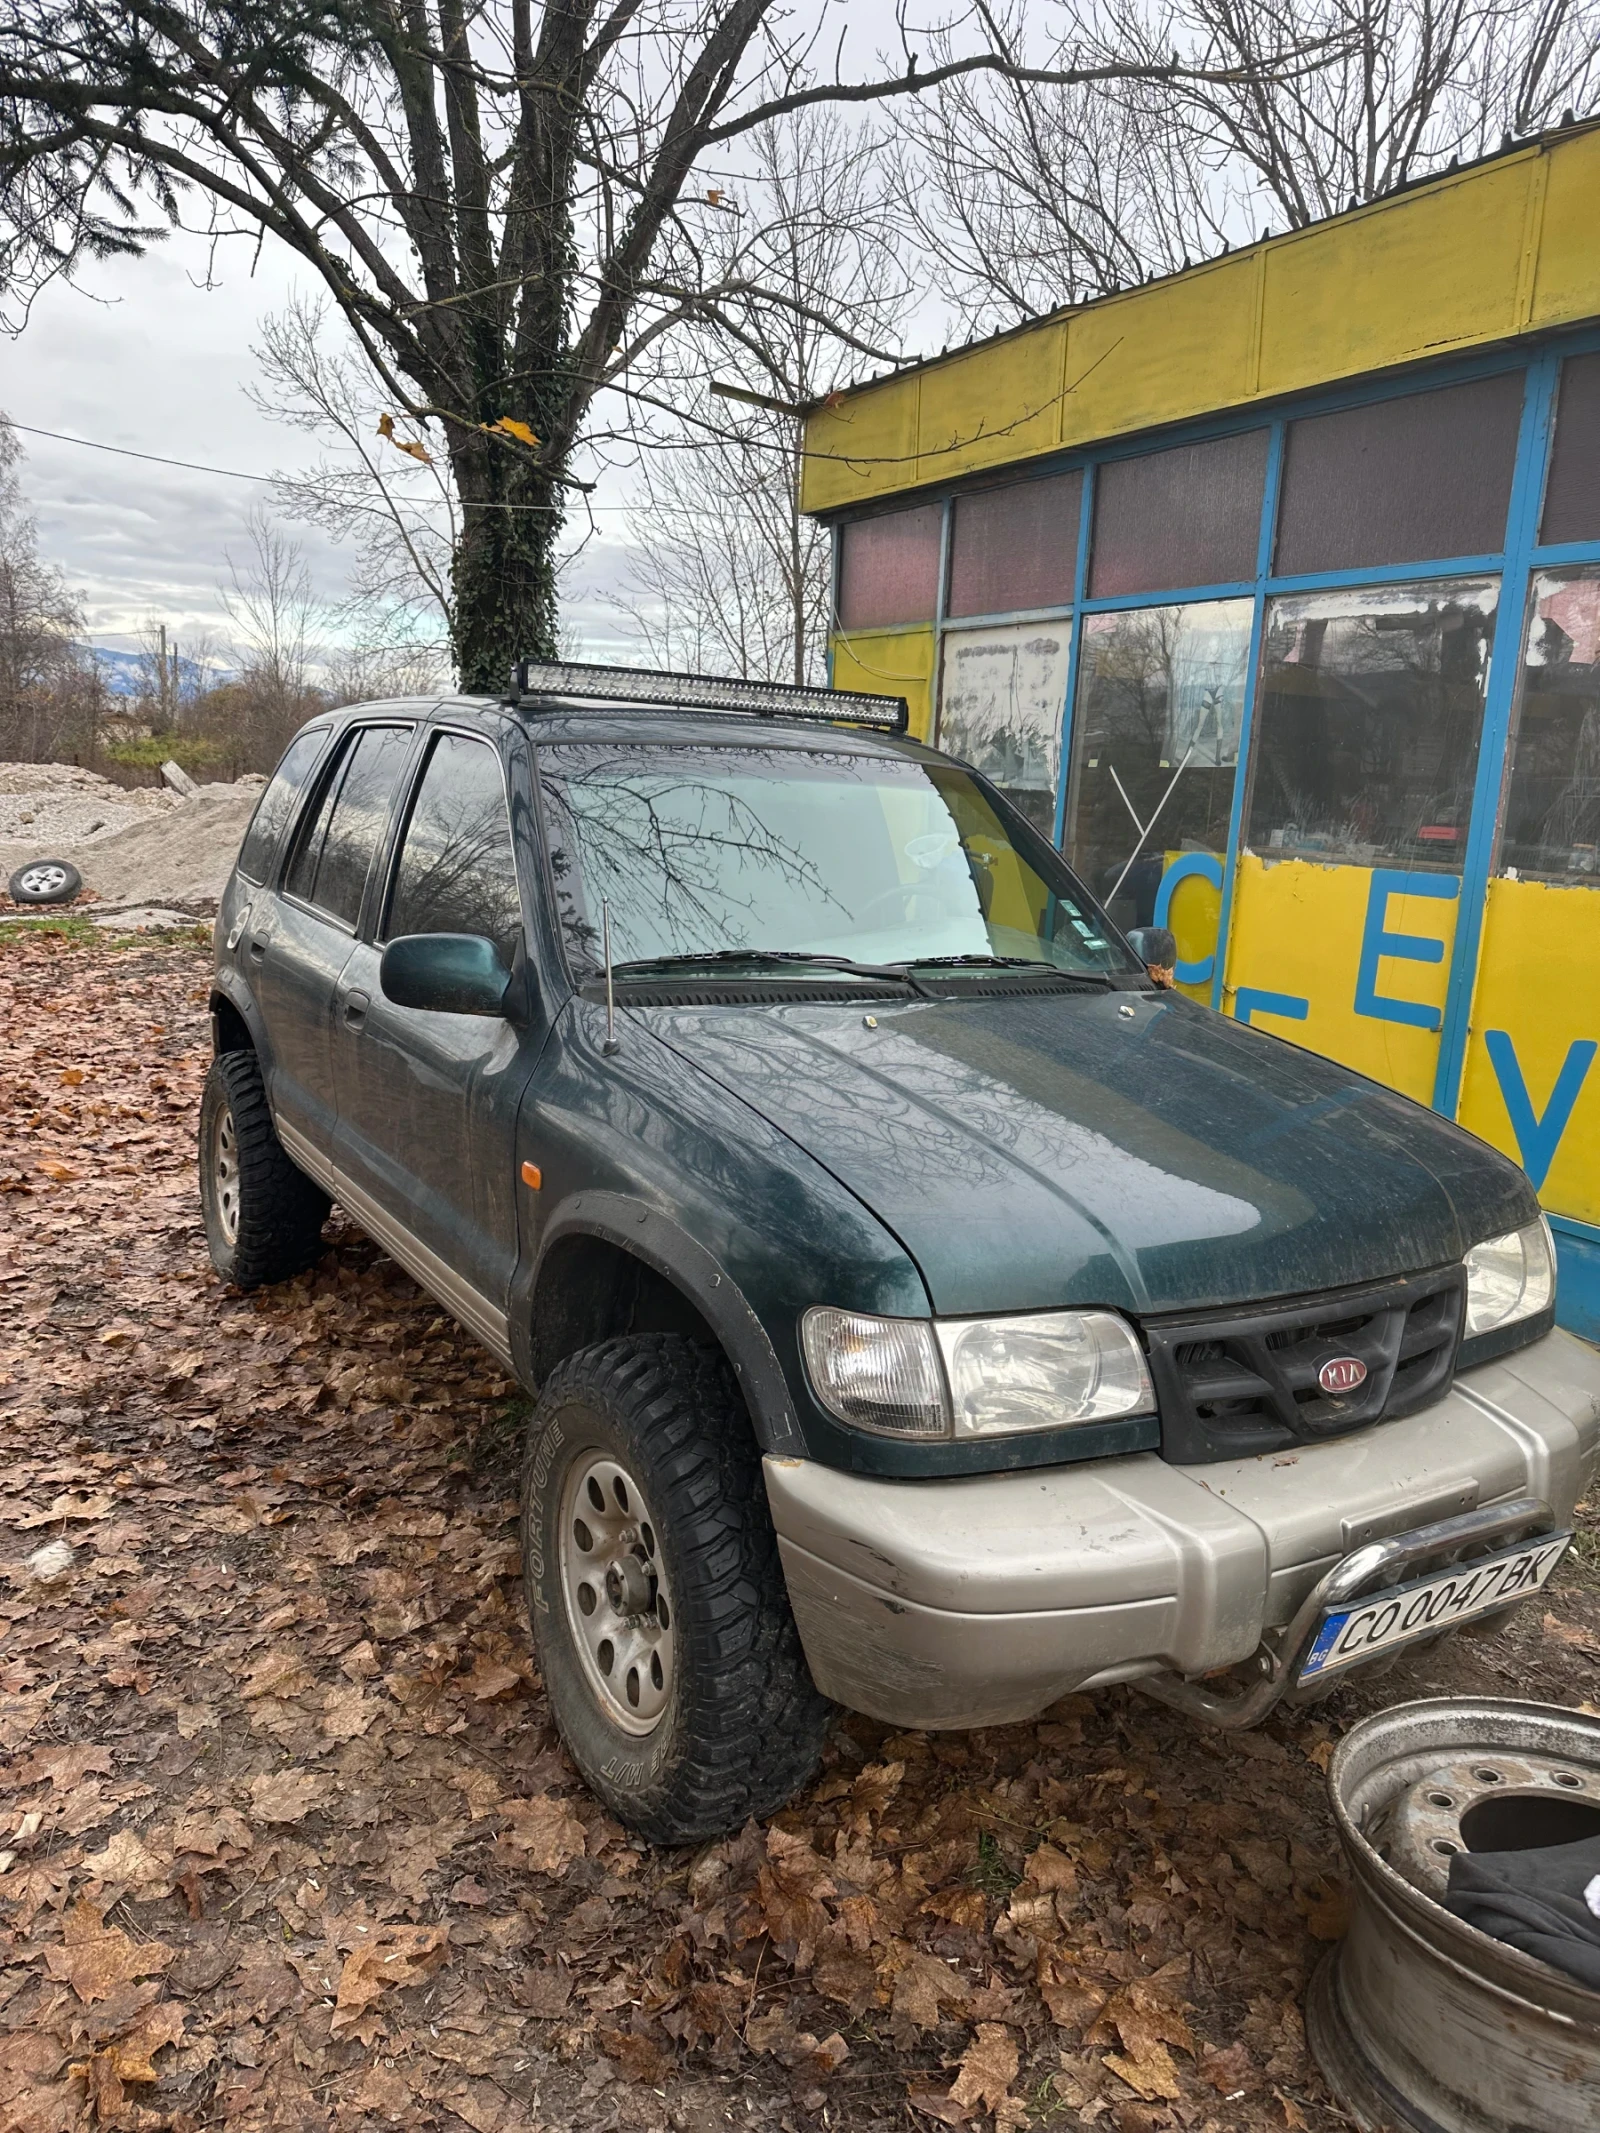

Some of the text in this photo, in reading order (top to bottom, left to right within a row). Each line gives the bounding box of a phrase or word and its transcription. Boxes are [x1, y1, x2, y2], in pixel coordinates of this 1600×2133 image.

[1326, 1363, 1361, 1386] KIA
[528, 1418, 565, 1614] FORTUNE
[1307, 1648, 1329, 1666] BG
[599, 1755, 645, 1787] M/T
